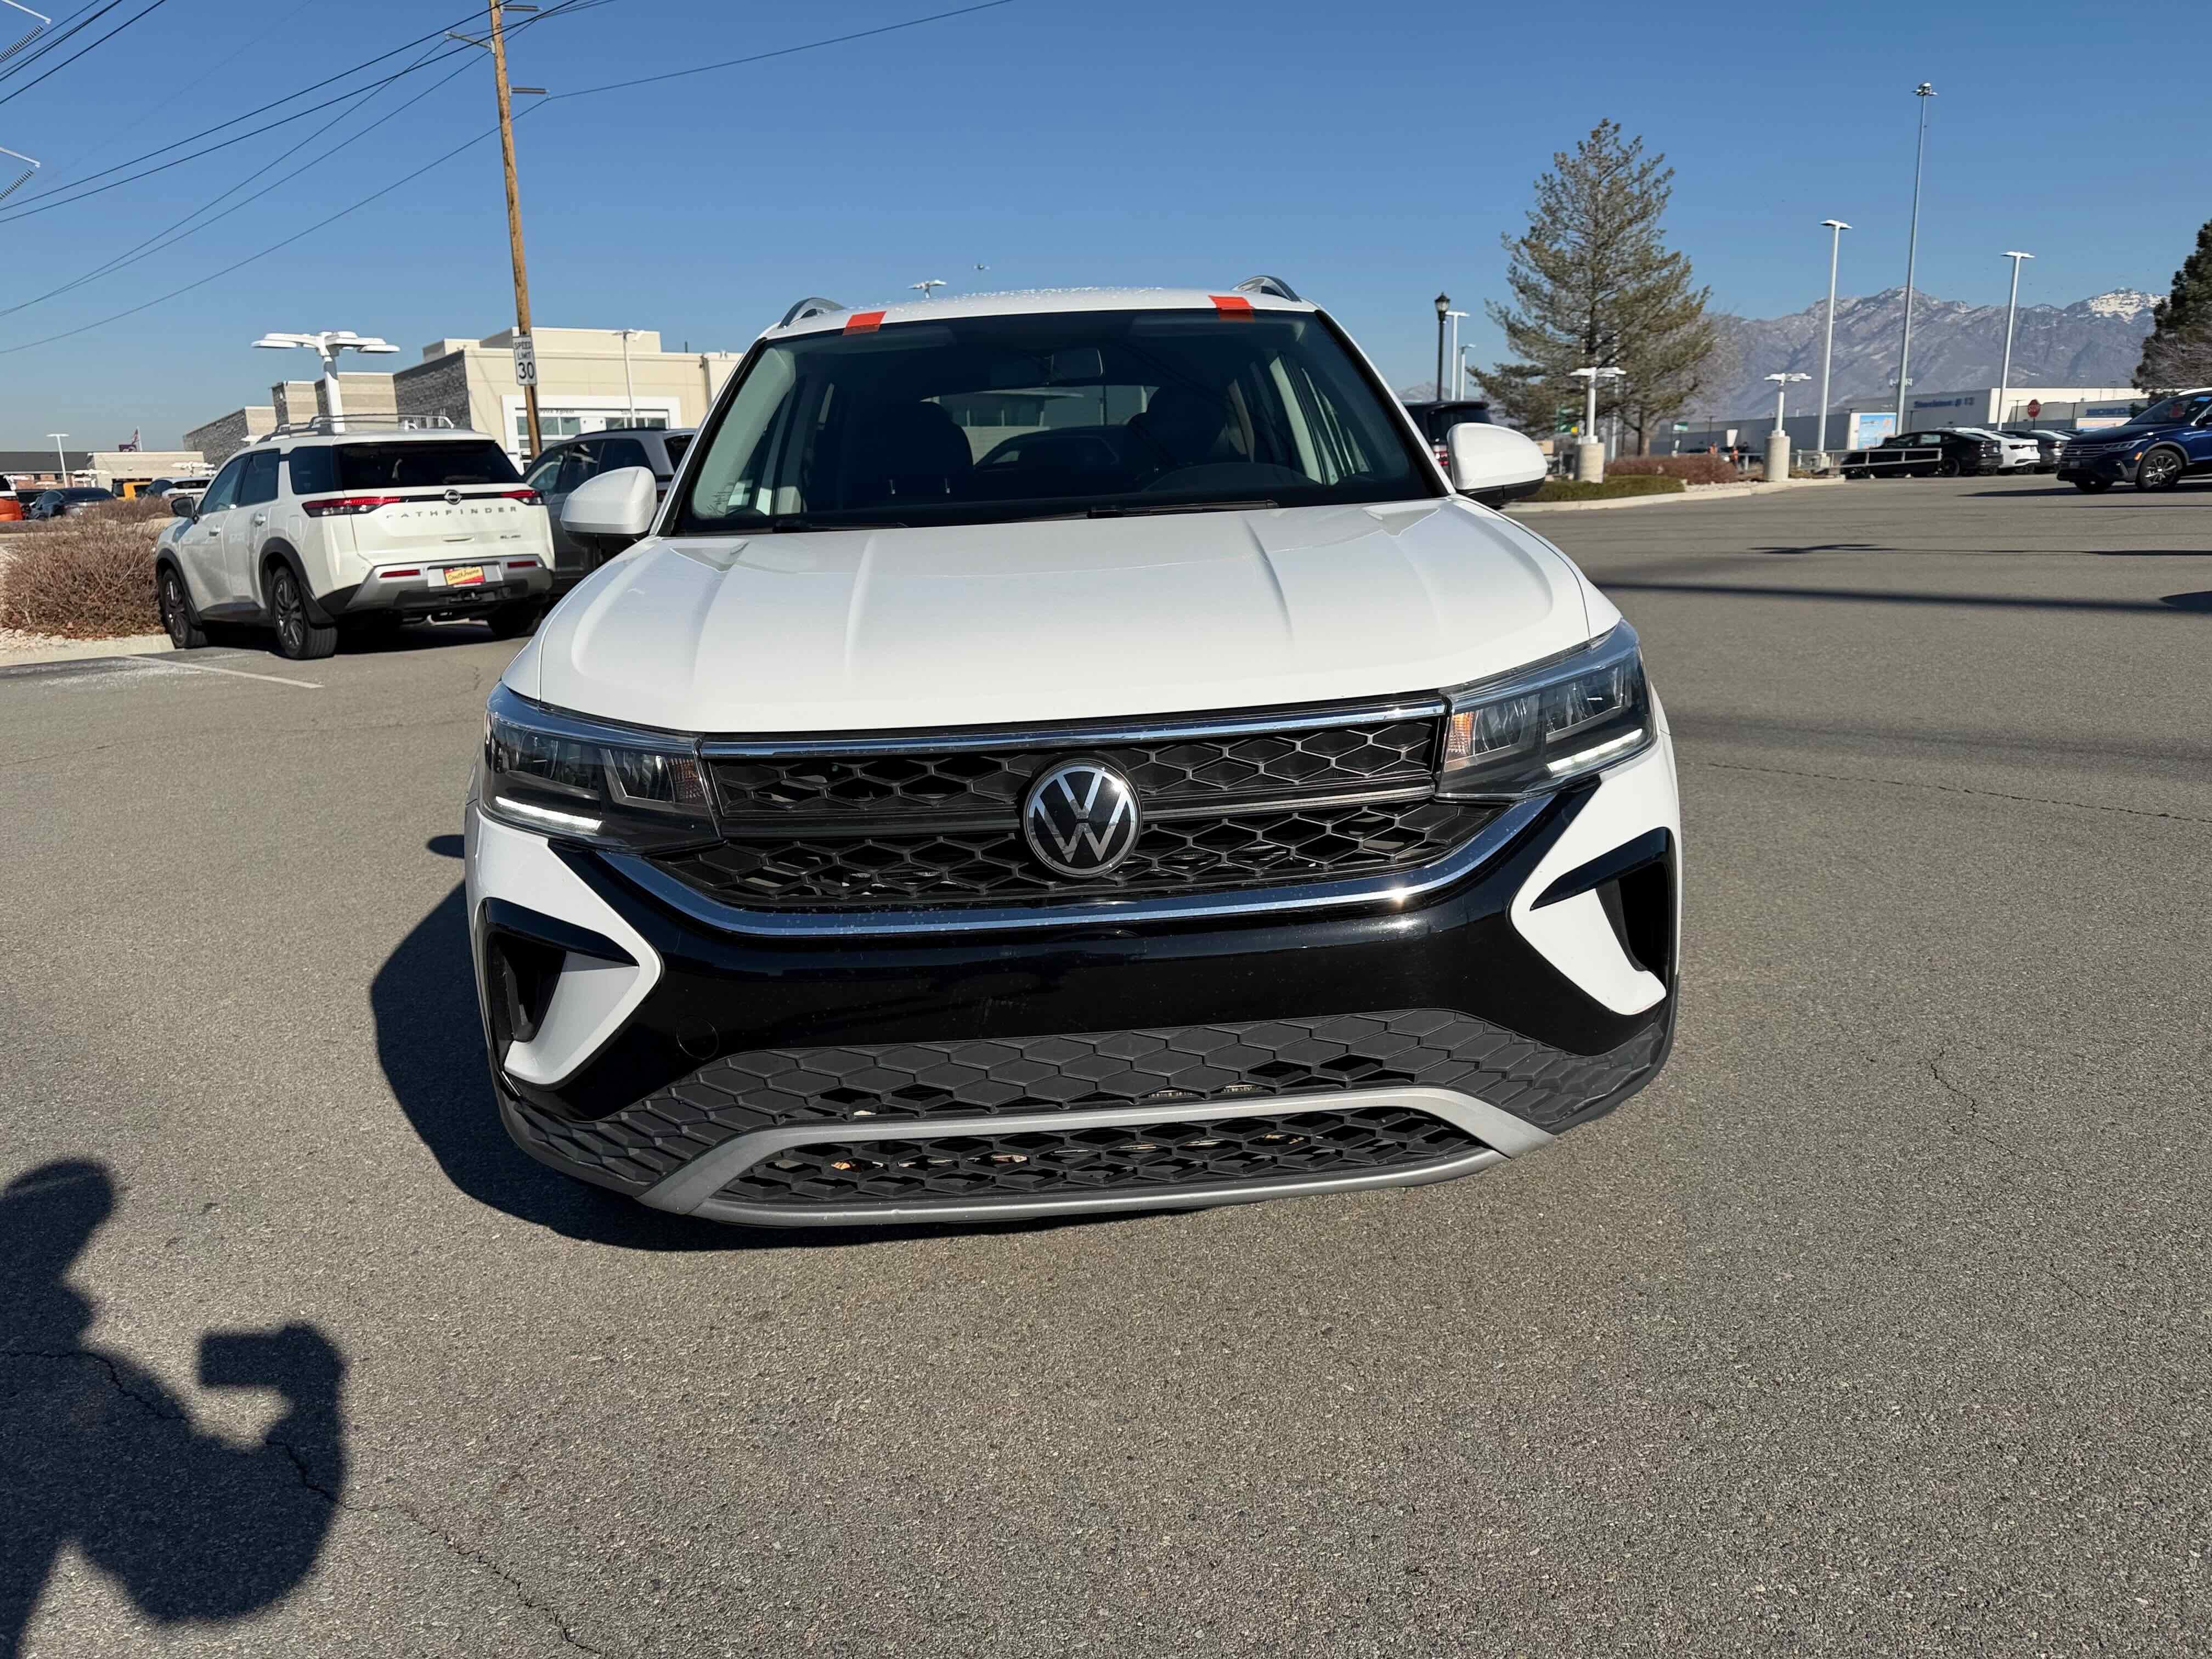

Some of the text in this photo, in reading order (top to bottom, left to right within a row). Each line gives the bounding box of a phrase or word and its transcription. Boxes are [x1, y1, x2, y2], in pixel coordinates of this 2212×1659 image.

[514, 341, 532, 349] SPEED
[518, 351, 531, 360] LIMIT
[518, 362, 534, 379] 30
[2028, 403, 2041, 413] STOP
[1031, 769, 1132, 865] VW
